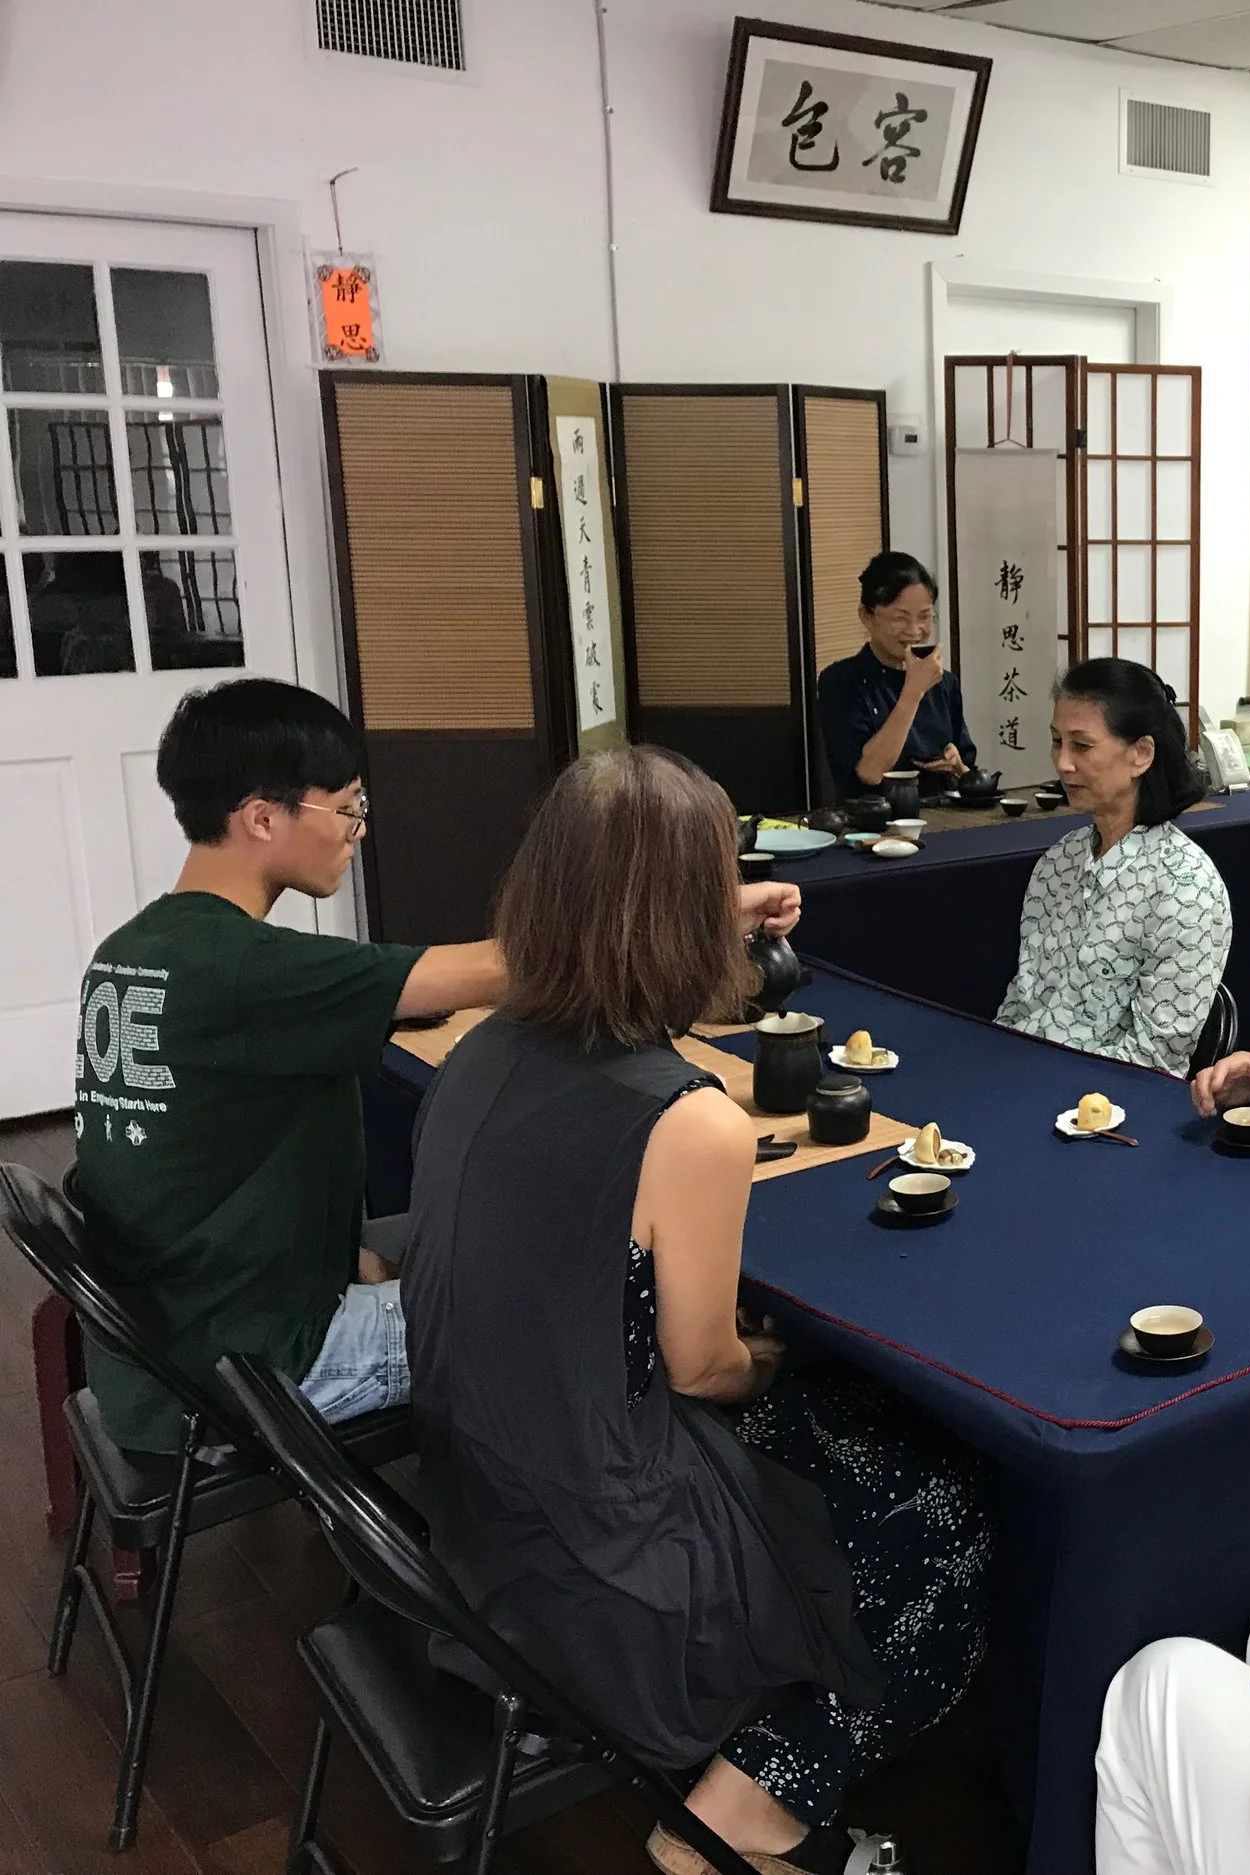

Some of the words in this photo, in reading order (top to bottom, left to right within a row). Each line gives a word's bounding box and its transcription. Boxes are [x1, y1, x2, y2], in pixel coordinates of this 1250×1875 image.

[782, 80, 928, 184] 包容
[331, 272, 367, 350] 靜思
[994, 559, 1028, 751] 靜思茶道
[75, 981, 176, 1089] OE
[80, 1089, 88, 1102] In
